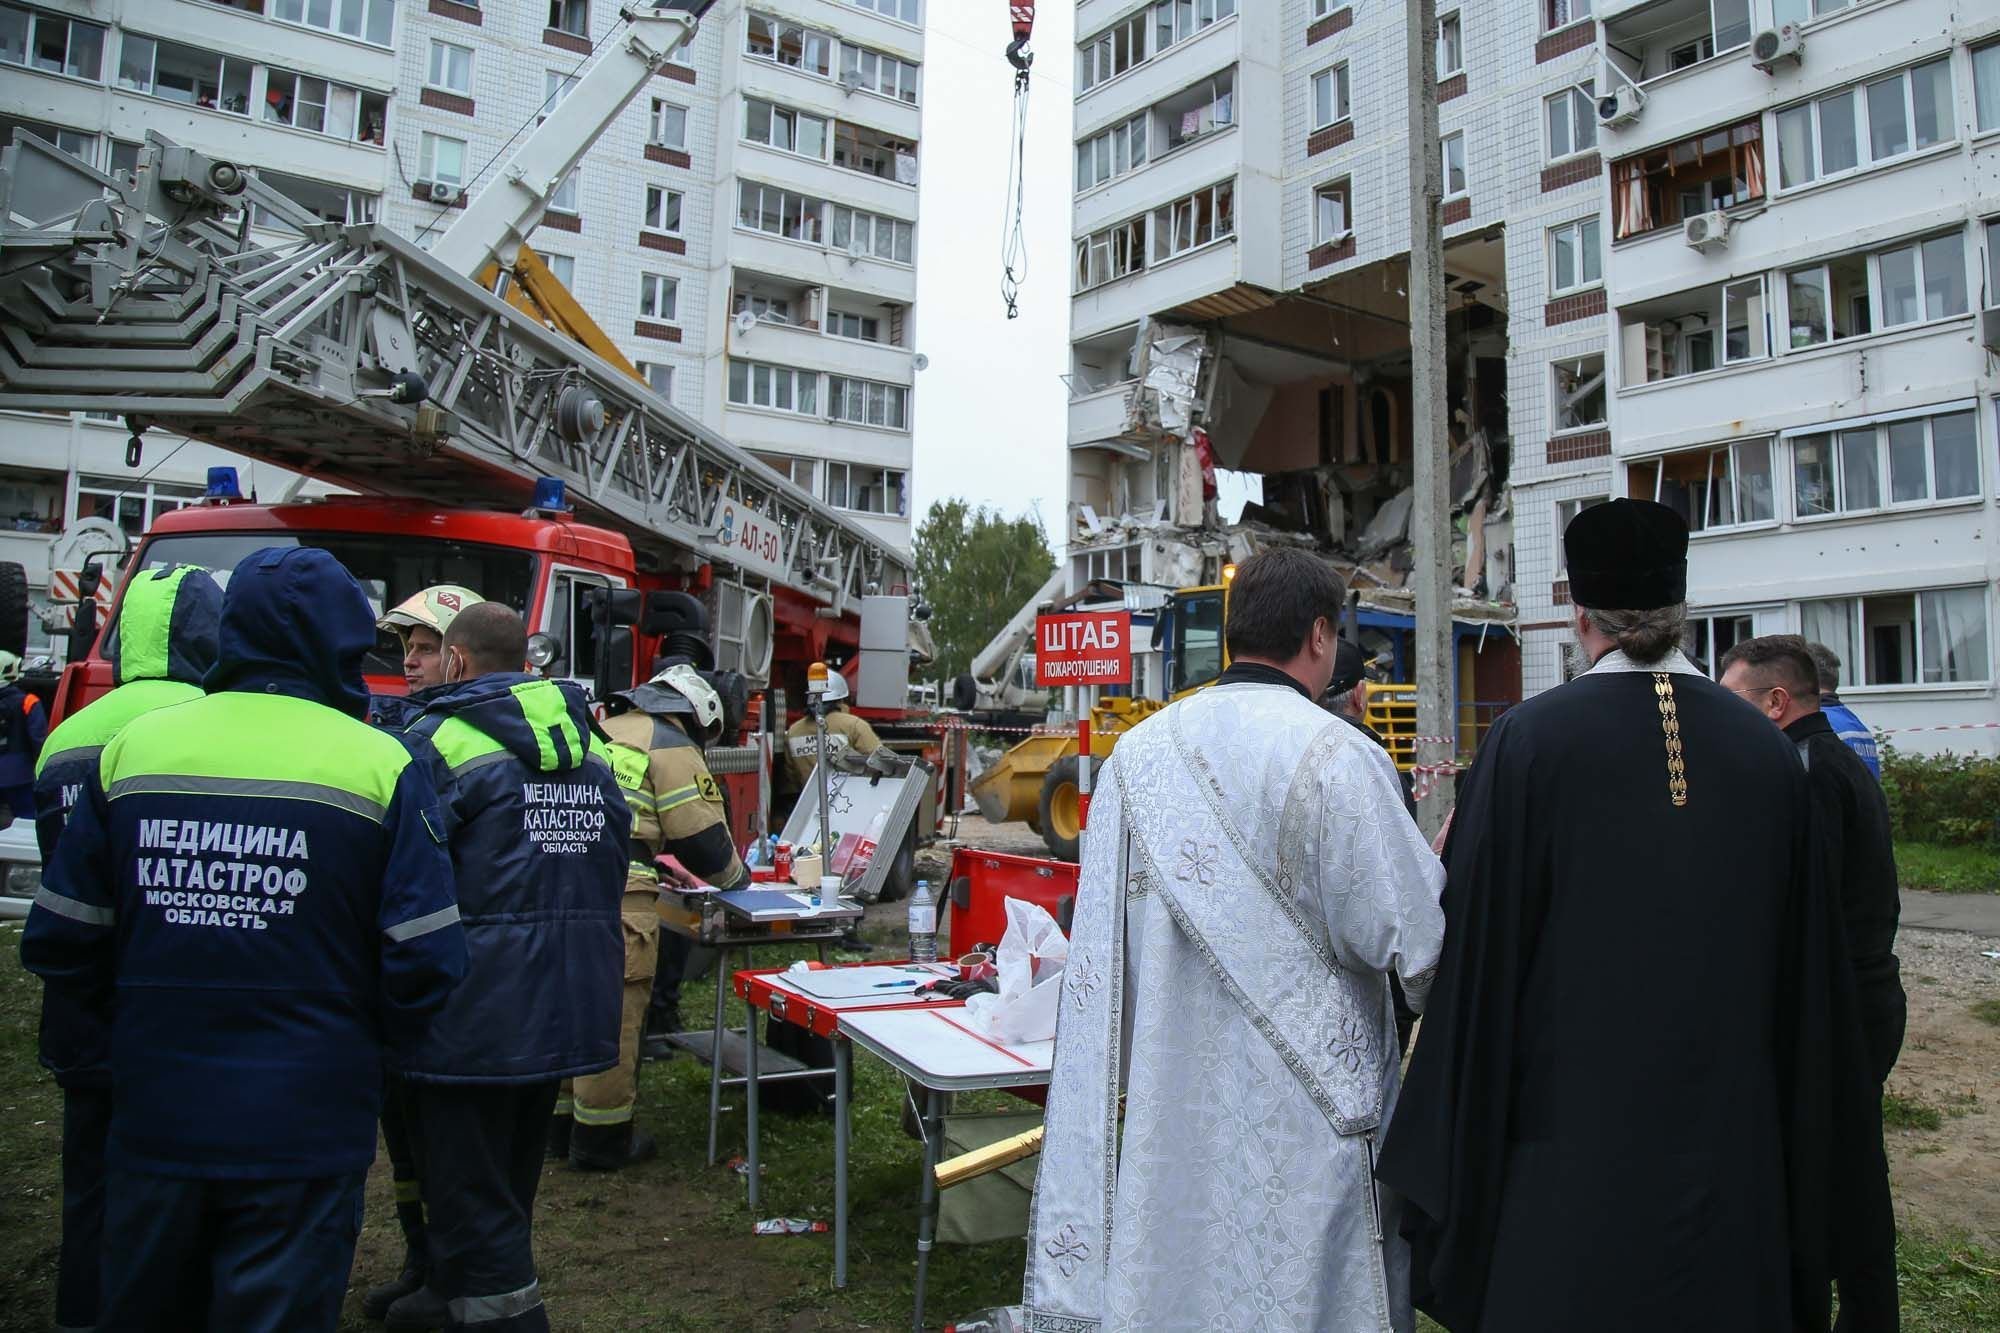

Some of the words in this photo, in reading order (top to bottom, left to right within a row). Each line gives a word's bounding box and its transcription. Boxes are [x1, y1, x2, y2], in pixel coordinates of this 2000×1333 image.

[740, 521, 778, 563] АЛ-50
[1044, 620, 1120, 652] ШТАБ
[1044, 659, 1120, 678] ПОЖАРОТУШЕНИЯ
[796, 743, 839, 755] РОСИИ
[523, 783, 605, 807] МЕДИЦИНА
[523, 808, 606, 830] КАТАСТРОФ
[139, 819, 309, 859] МЕДИЦИНА
[530, 830, 601, 842] МОСКОВСКАЯ
[542, 842, 588, 854] ОБЛАСТЬ
[138, 857, 307, 896] КАТАСТРОФ
[145, 890, 295, 915] МОСКОВСКАЯ
[164, 908, 268, 930] ОБЛАСТЬ
